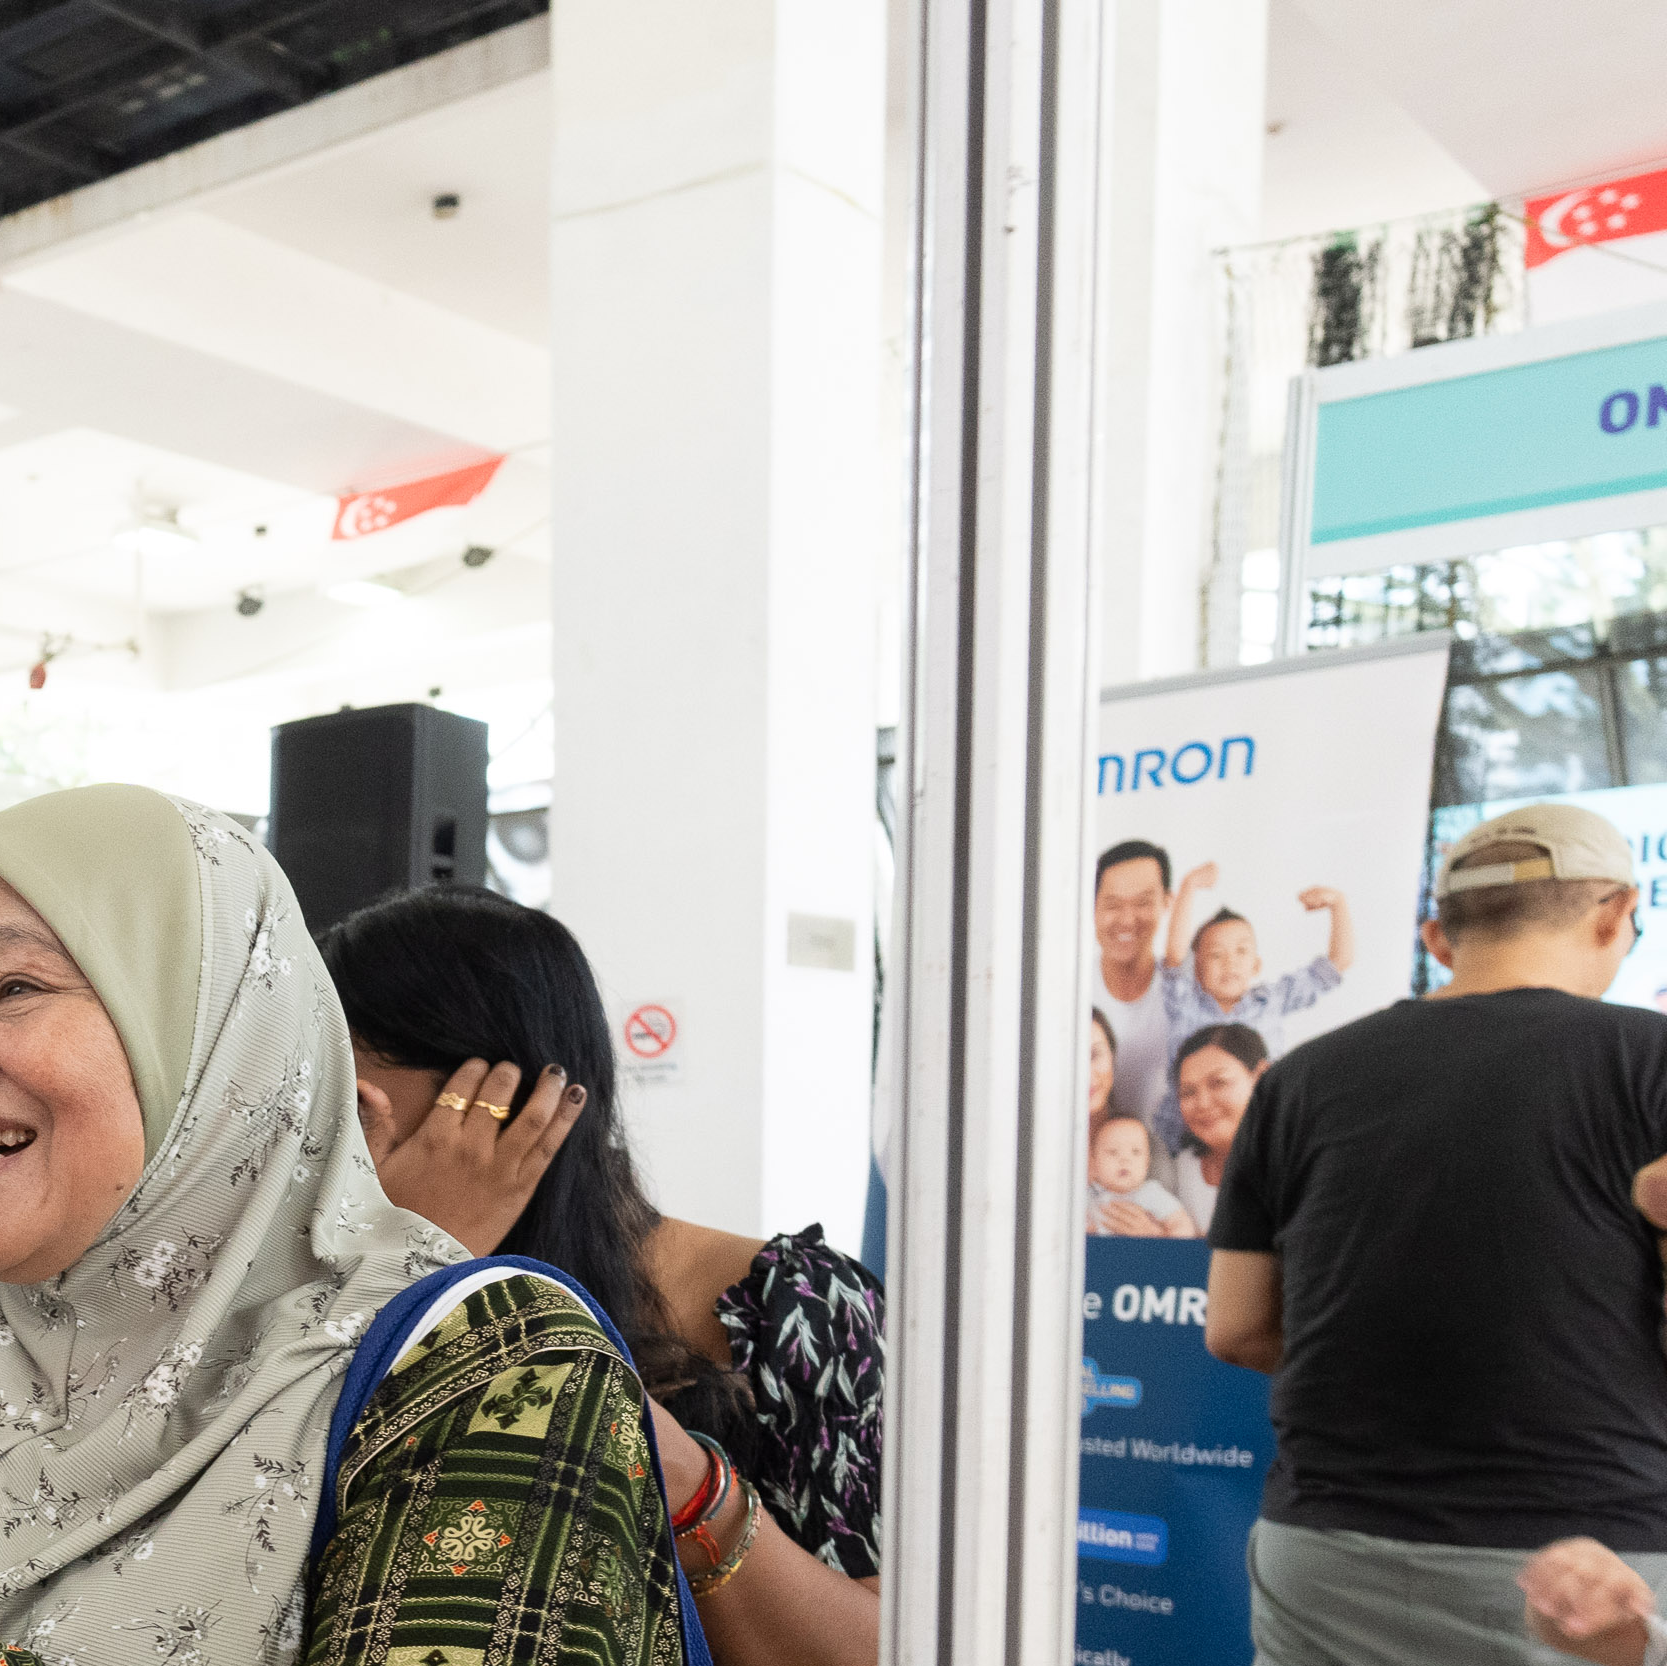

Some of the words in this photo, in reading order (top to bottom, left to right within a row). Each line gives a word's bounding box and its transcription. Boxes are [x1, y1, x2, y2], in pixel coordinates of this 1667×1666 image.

[1080, 1436, 1127, 1460] sted
[1130, 1437, 1255, 1469] Worldwide
[1098, 1583, 1175, 1617] Choice
